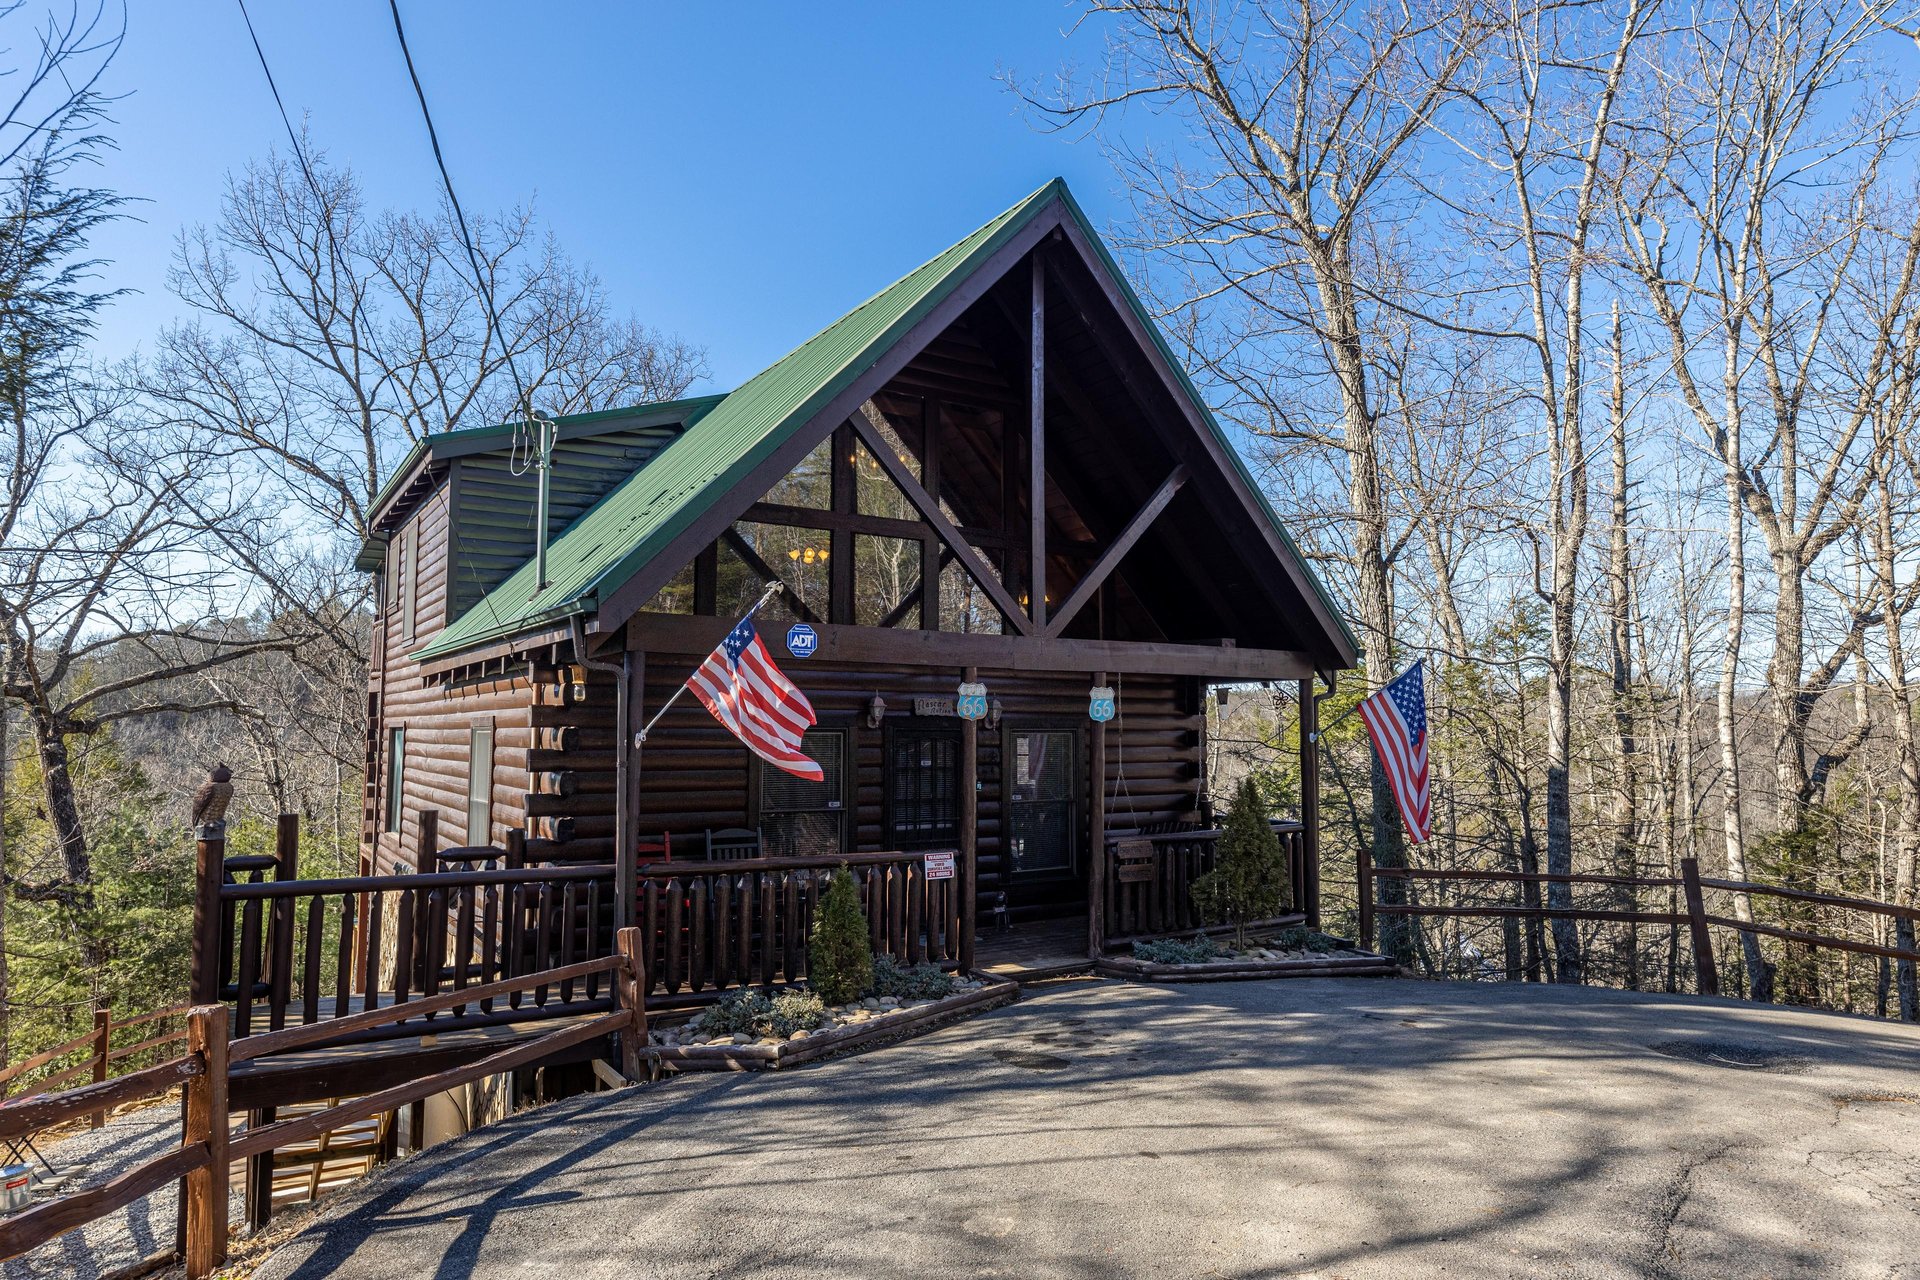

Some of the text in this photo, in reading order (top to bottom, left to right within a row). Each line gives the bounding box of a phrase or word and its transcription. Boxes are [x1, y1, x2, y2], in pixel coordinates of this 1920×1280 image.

[791, 634, 813, 647] ADT
[962, 697, 983, 716] 66
[1093, 700, 1111, 717] 66
